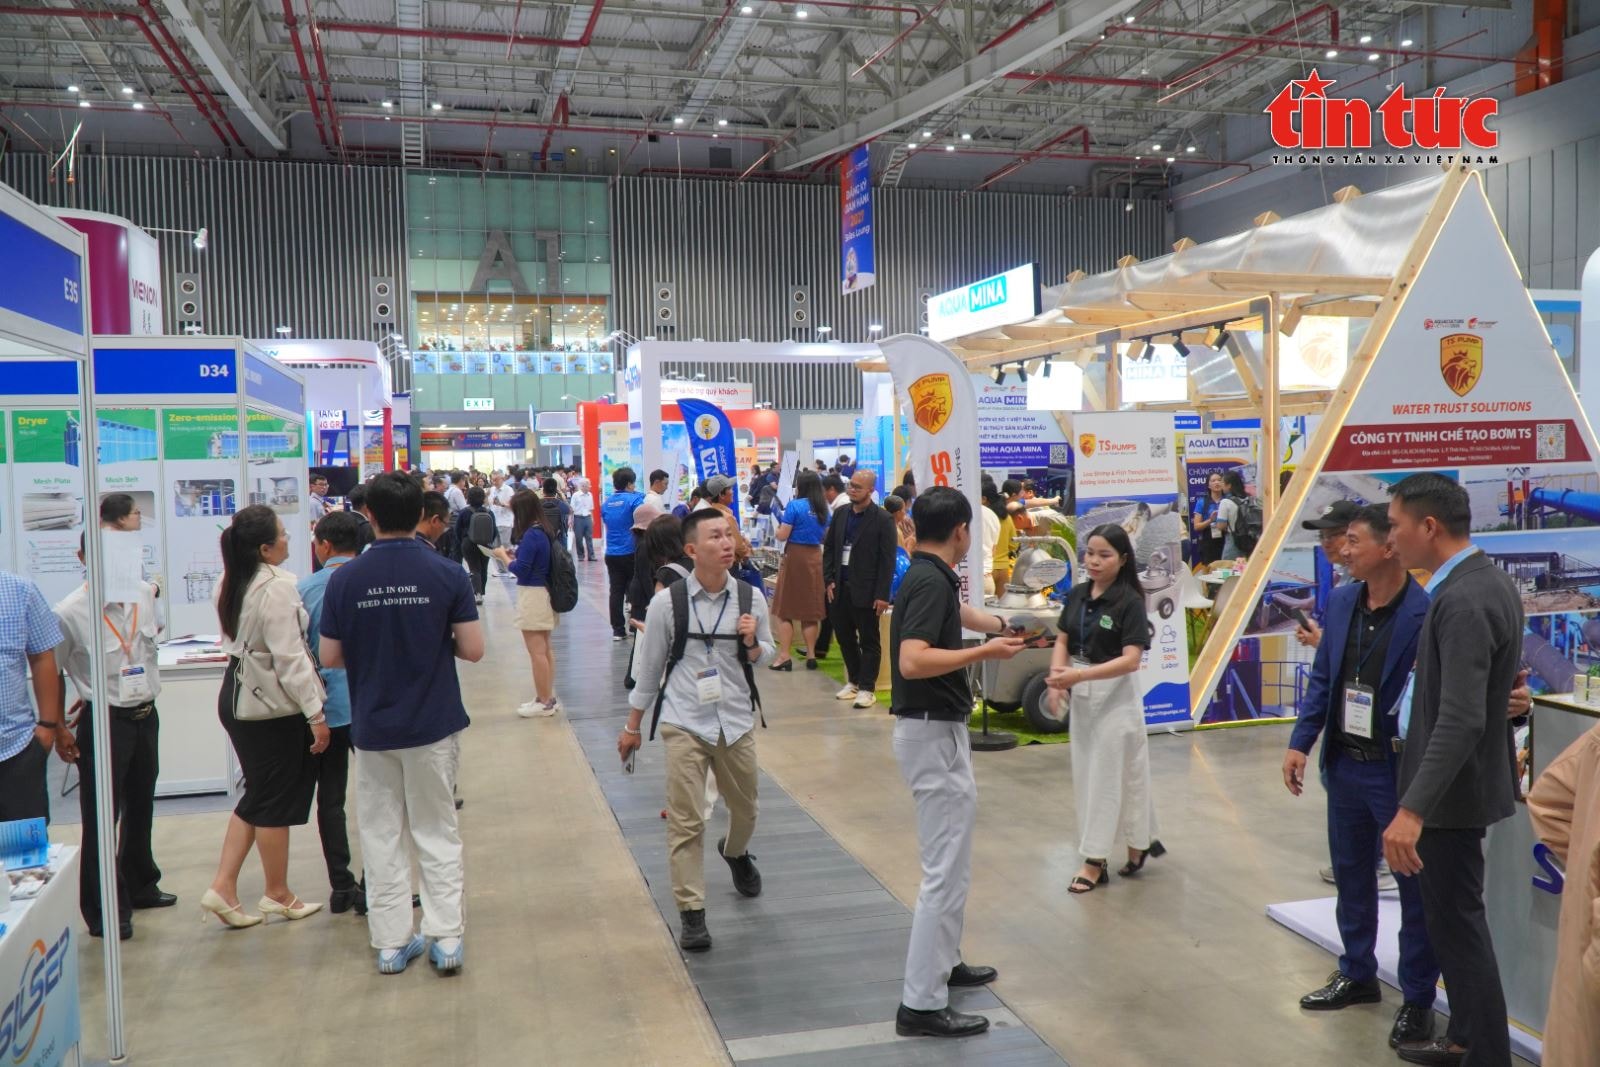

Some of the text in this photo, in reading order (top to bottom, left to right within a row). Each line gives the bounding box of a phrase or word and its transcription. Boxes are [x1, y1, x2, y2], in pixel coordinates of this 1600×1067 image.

[63, 276, 79, 305] E35
[938, 280, 1006, 318] AQUA MINA
[199, 363, 229, 378] D34
[718, 387, 739, 396] khách
[978, 396, 1002, 404] AQUA
[1392, 401, 1532, 415] WATER TRUST SOLUTIONS
[18, 416, 48, 426] Dryer
[169, 413, 238, 422] Zero-emission
[1349, 426, 1532, 445] CÔNG TY TNHH CHẾ TẠO BƠM TS
[1098, 440, 1137, 451] TS PUMPS
[1188, 438, 1247, 448] AQUA MINA
[367, 585, 418, 595] ALL IN ONE
[357, 597, 430, 608] FEED ADDITIVES
